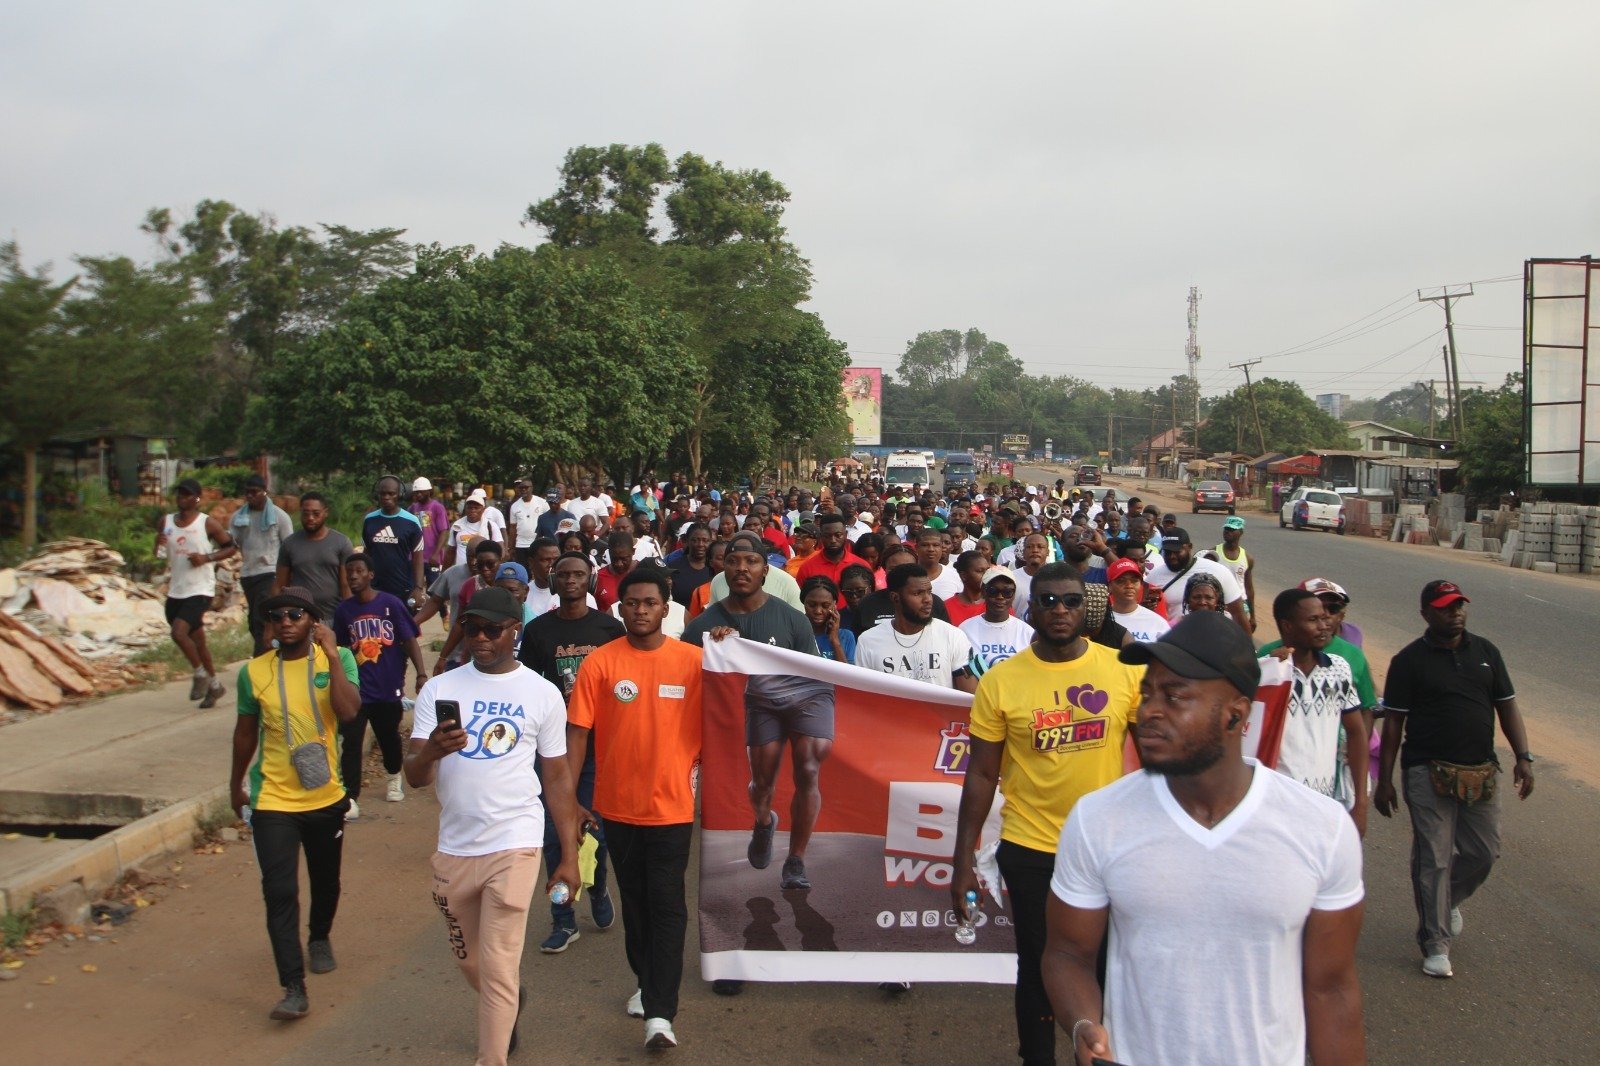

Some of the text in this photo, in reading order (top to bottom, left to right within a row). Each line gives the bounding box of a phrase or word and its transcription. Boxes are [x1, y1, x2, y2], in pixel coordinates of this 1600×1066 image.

[372, 535, 399, 544] adidas
[981, 644, 1017, 654] DEKA
[472, 700, 526, 720] DEKA
[1075, 723, 1101, 740] FM
